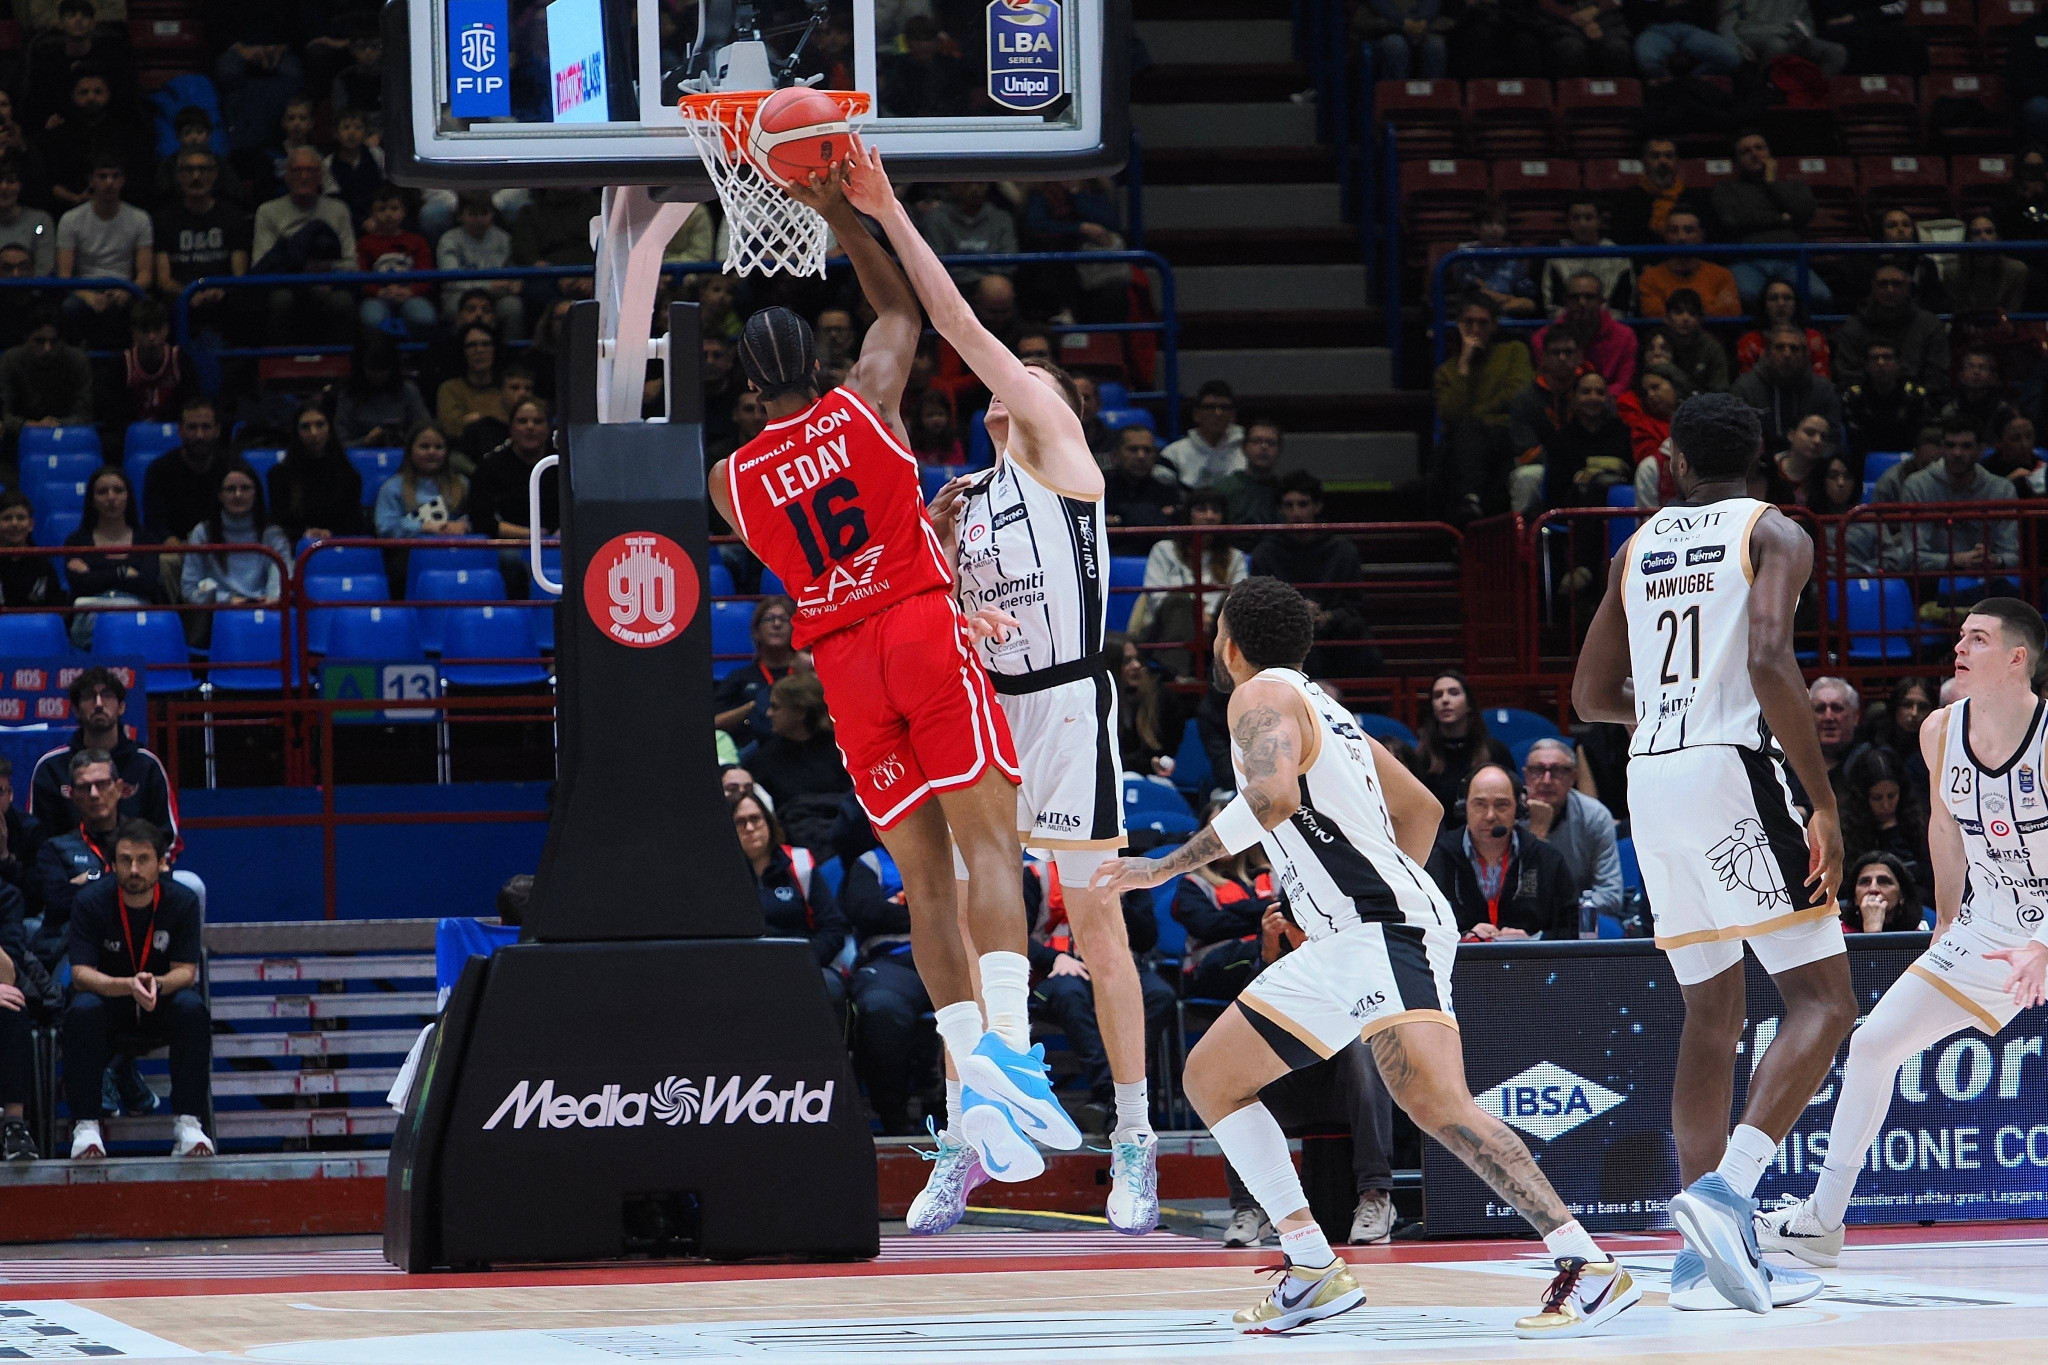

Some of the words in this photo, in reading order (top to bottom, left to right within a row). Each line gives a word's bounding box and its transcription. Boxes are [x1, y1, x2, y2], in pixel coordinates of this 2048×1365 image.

[998, 32, 1053, 53] LBA
[1008, 56, 1034, 64] SERIE
[1035, 56, 1043, 64] A
[456, 76, 503, 94] FIP
[1004, 76, 1049, 96] Unipol
[804, 407, 851, 444] AON
[760, 434, 851, 508] LEDAY
[785, 476, 870, 578] 16
[1654, 511, 1728, 535] CAVIT
[1642, 554, 1675, 571] Melinda
[608, 543, 676, 625] 90
[849, 579, 891, 602] ARMANI
[1646, 572, 1716, 602] MAWUGBE
[1656, 604, 1702, 686] 21
[388, 673, 432, 702] 13
[0, 698, 20, 718] DS
[1950, 765, 1972, 794] 23
[1048, 811, 1081, 828] ITAS
[2002, 847, 2031, 859] ITAS
[1356, 990, 1386, 1014] ITAS
[482, 1079, 650, 1130] Media
[700, 1074, 835, 1125] World
[1500, 1085, 1593, 1118] IBSA
